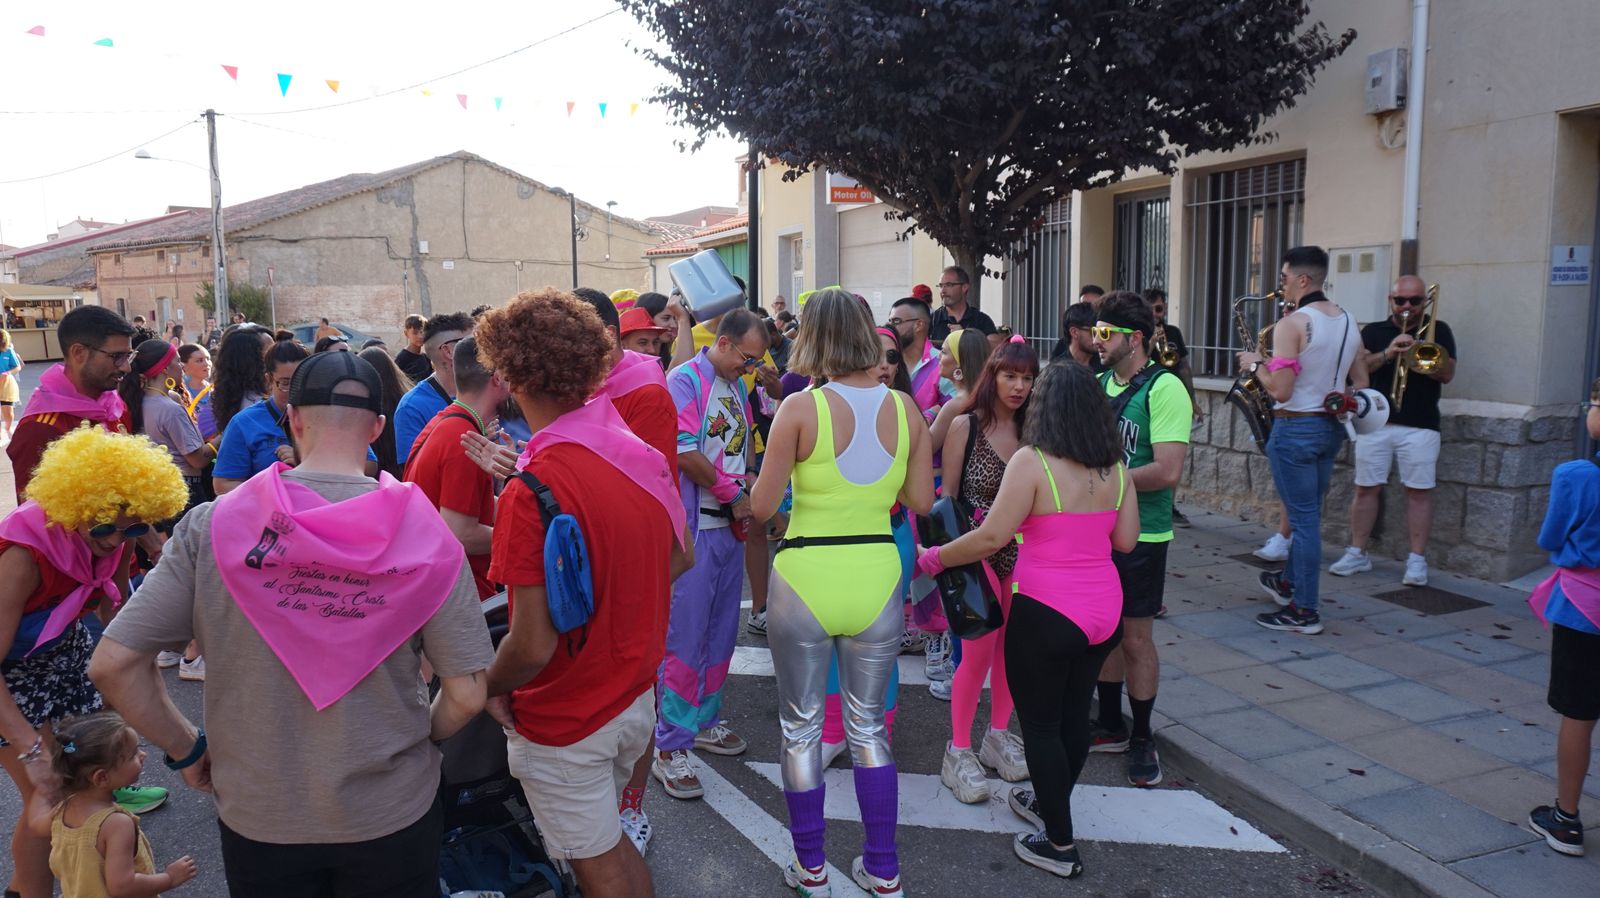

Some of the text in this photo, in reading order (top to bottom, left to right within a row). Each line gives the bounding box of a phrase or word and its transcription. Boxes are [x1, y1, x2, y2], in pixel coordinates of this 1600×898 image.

[834, 191, 872, 199] Motor Oil
[288, 566, 370, 587] Fiestas en honor
[263, 578, 278, 588] al
[342, 591, 386, 605] Cristo
[276, 597, 367, 619] de las Batallas
